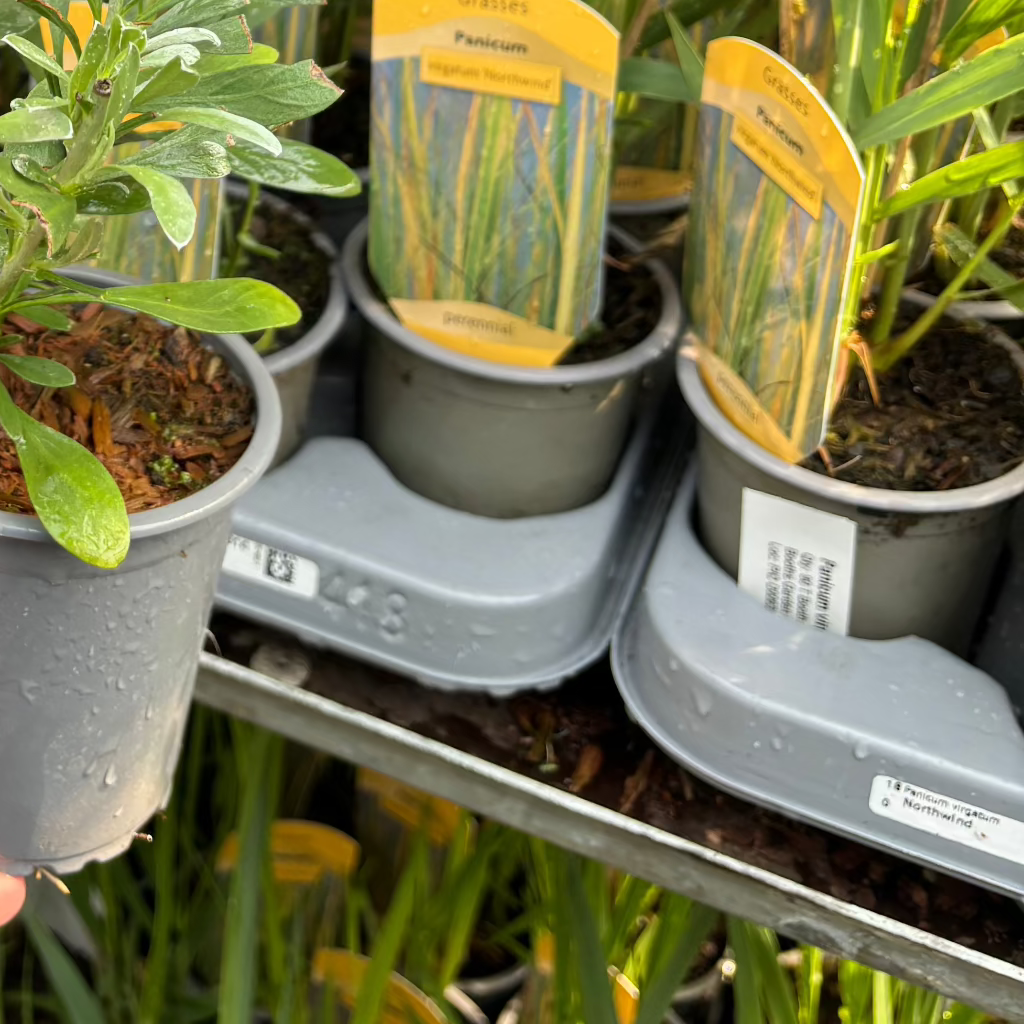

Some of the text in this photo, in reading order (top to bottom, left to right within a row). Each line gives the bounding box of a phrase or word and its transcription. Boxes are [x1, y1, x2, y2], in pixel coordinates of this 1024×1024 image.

[454, 29, 528, 54] Panicum
[762, 66, 809, 117] Grasses
[756, 105, 804, 156] Panicum
[817, 556, 837, 612] Panicum
[903, 797, 973, 828] Northwind
[904, 784, 948, 808] Panicum
[952, 803, 1001, 825] virgatum
